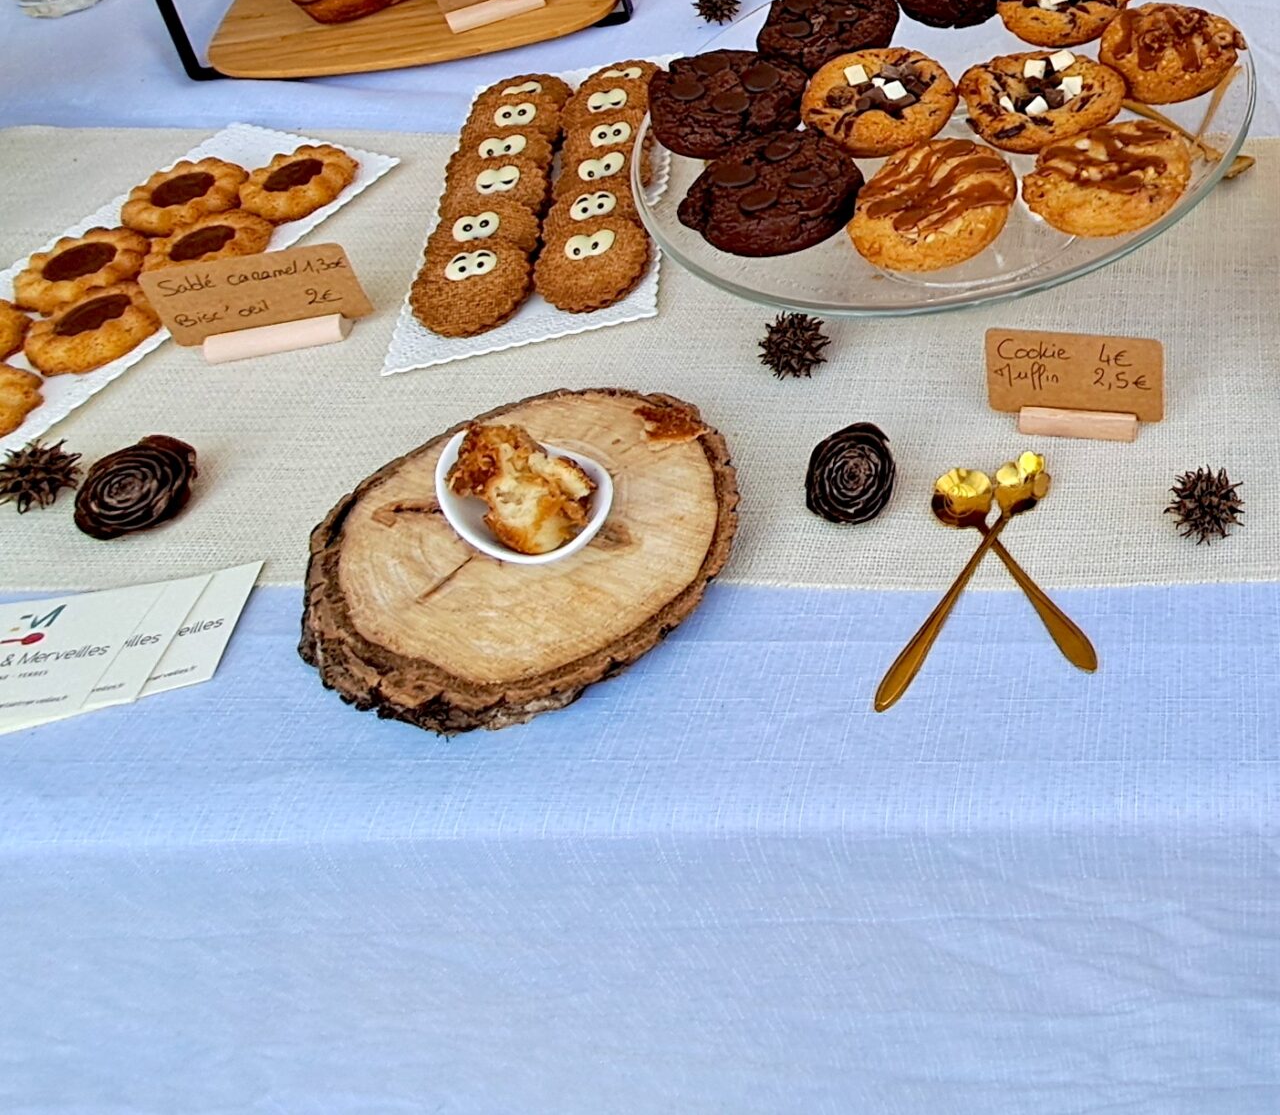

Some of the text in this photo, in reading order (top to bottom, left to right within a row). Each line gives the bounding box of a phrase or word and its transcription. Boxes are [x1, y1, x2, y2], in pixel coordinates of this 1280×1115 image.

[157, 257, 348, 298] Sablé caramel 1,30€
[305, 288, 344, 306] 2€
[996, 338, 1133, 368] Cookie 4€
[993, 362, 1153, 392] Muffin 2,5€
[16, 644, 111, 667] Merveilles
